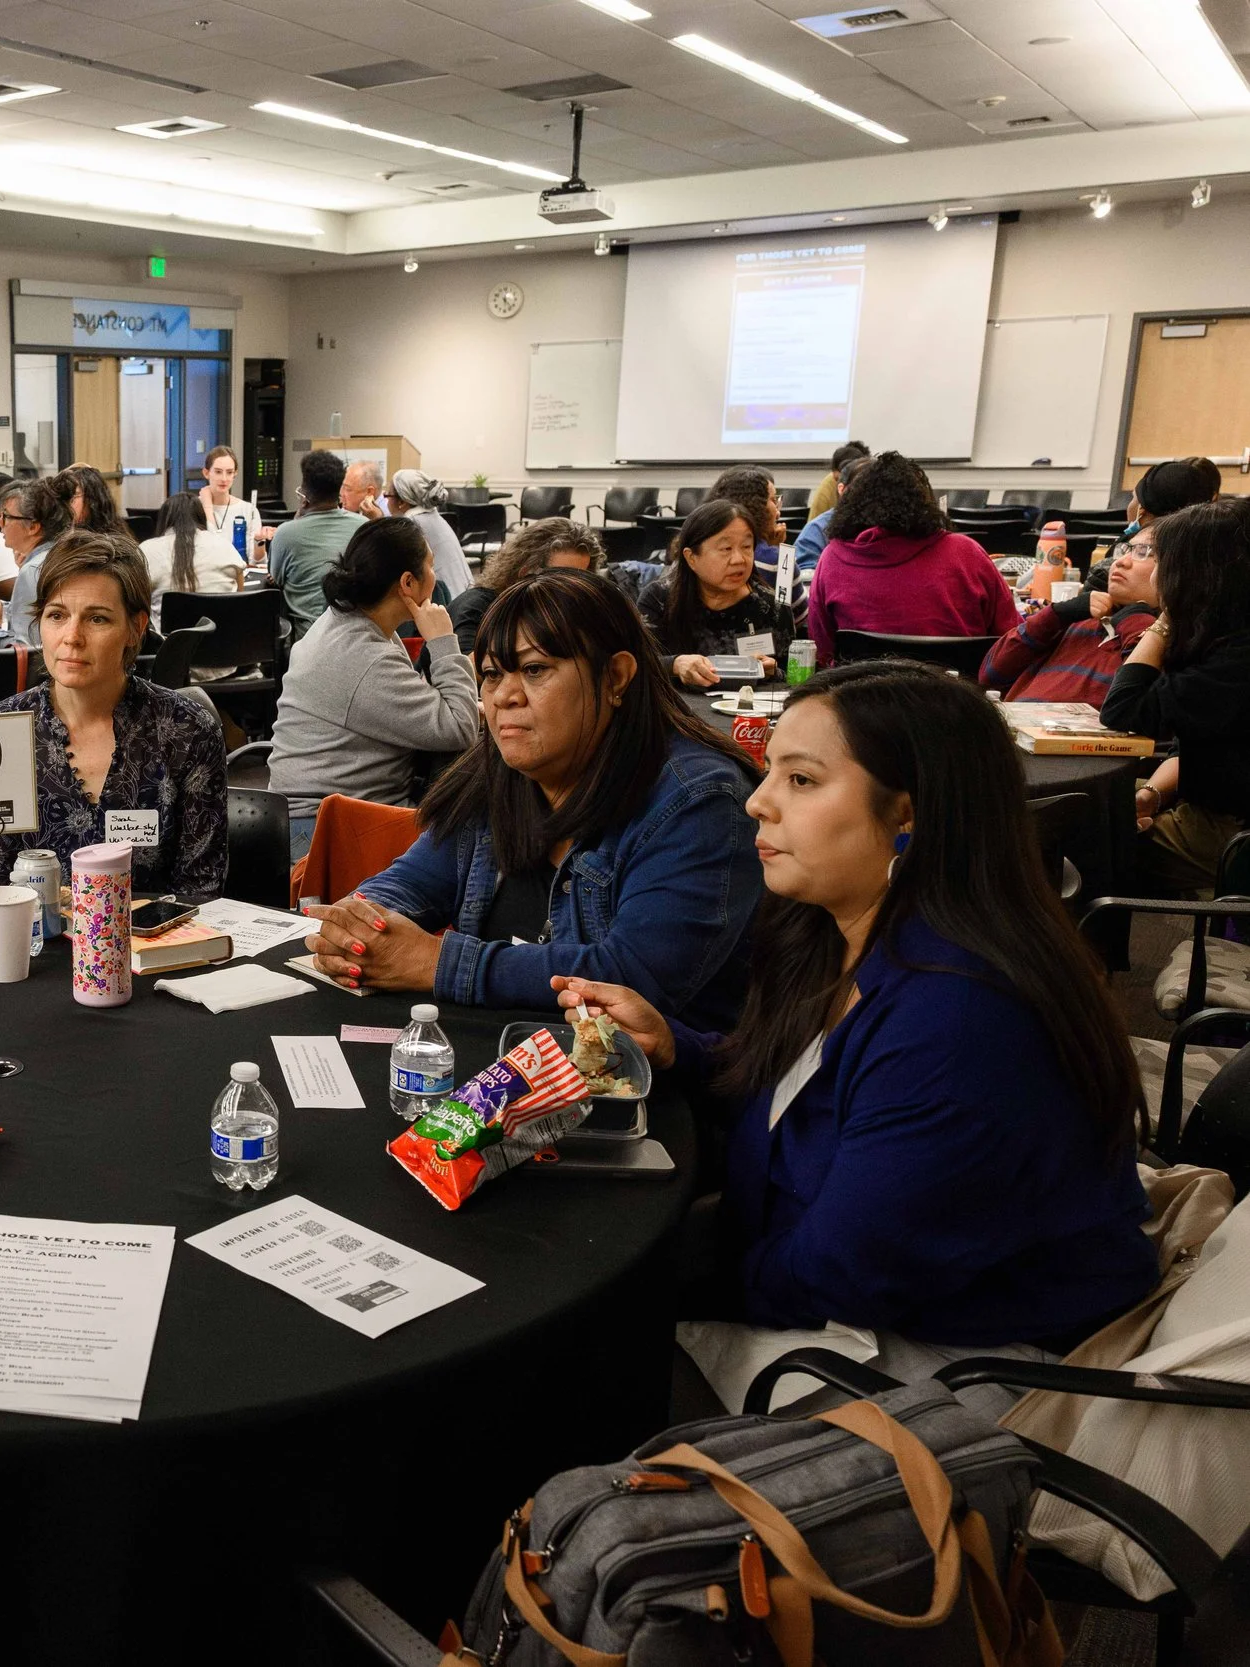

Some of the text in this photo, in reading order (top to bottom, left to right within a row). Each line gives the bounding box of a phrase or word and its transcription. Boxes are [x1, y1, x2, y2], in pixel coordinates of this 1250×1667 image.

[736, 253, 757, 263] FOR
[758, 249, 793, 261] THOSE
[795, 247, 816, 258] YET
[817, 246, 833, 256] TO
[781, 553, 789, 574] 4
[1094, 743, 1108, 752] the
[1109, 744, 1132, 753] Game
[510, 1045, 538, 1071] m's
[476, 1070, 500, 1089] HIPS
[487, 1063, 512, 1084] TATO
[429, 1156, 450, 1177] HOT!
[219, 1210, 307, 1248] IMPORTANT QR CODES
[43, 1236, 77, 1244] YET
[104, 1240, 152, 1249] COME
[240, 1241, 279, 1259] SPEAKER
[37, 1251, 98, 1260] AGENDA
[269, 1249, 317, 1271] CONVENING
[281, 1258, 326, 1277] FEEDBACK
